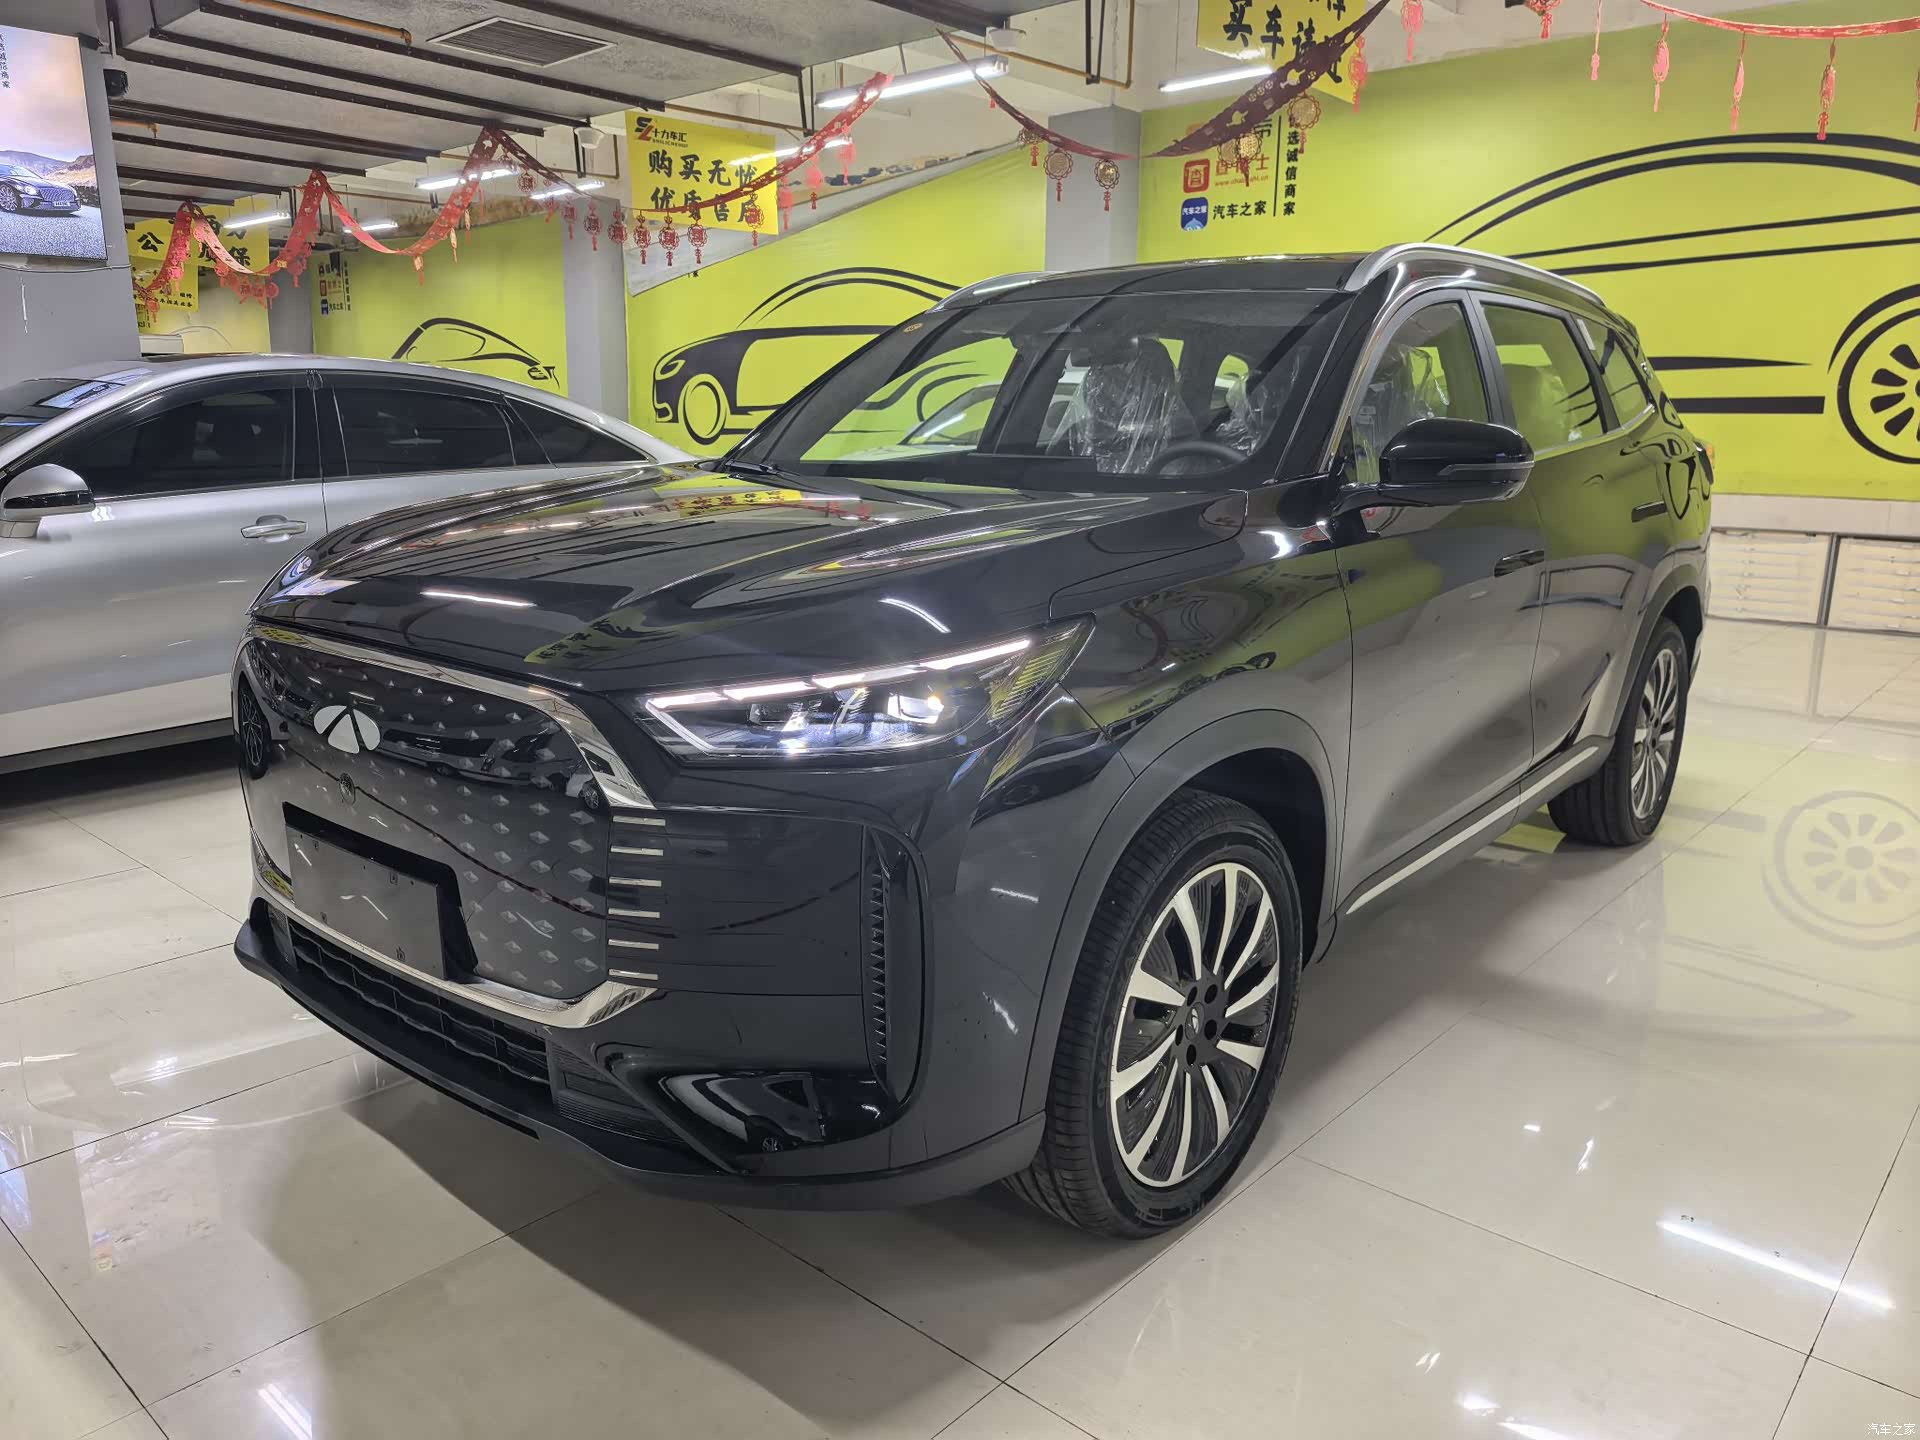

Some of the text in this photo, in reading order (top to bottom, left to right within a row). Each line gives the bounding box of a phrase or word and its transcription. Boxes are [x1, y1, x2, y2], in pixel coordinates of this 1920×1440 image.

[652, 128, 688, 143] 十力车汇
[648, 149, 758, 188] 购买无忧
[1283, 112, 1300, 217] 选诚信商家
[1212, 200, 1267, 220] 汽车之家
